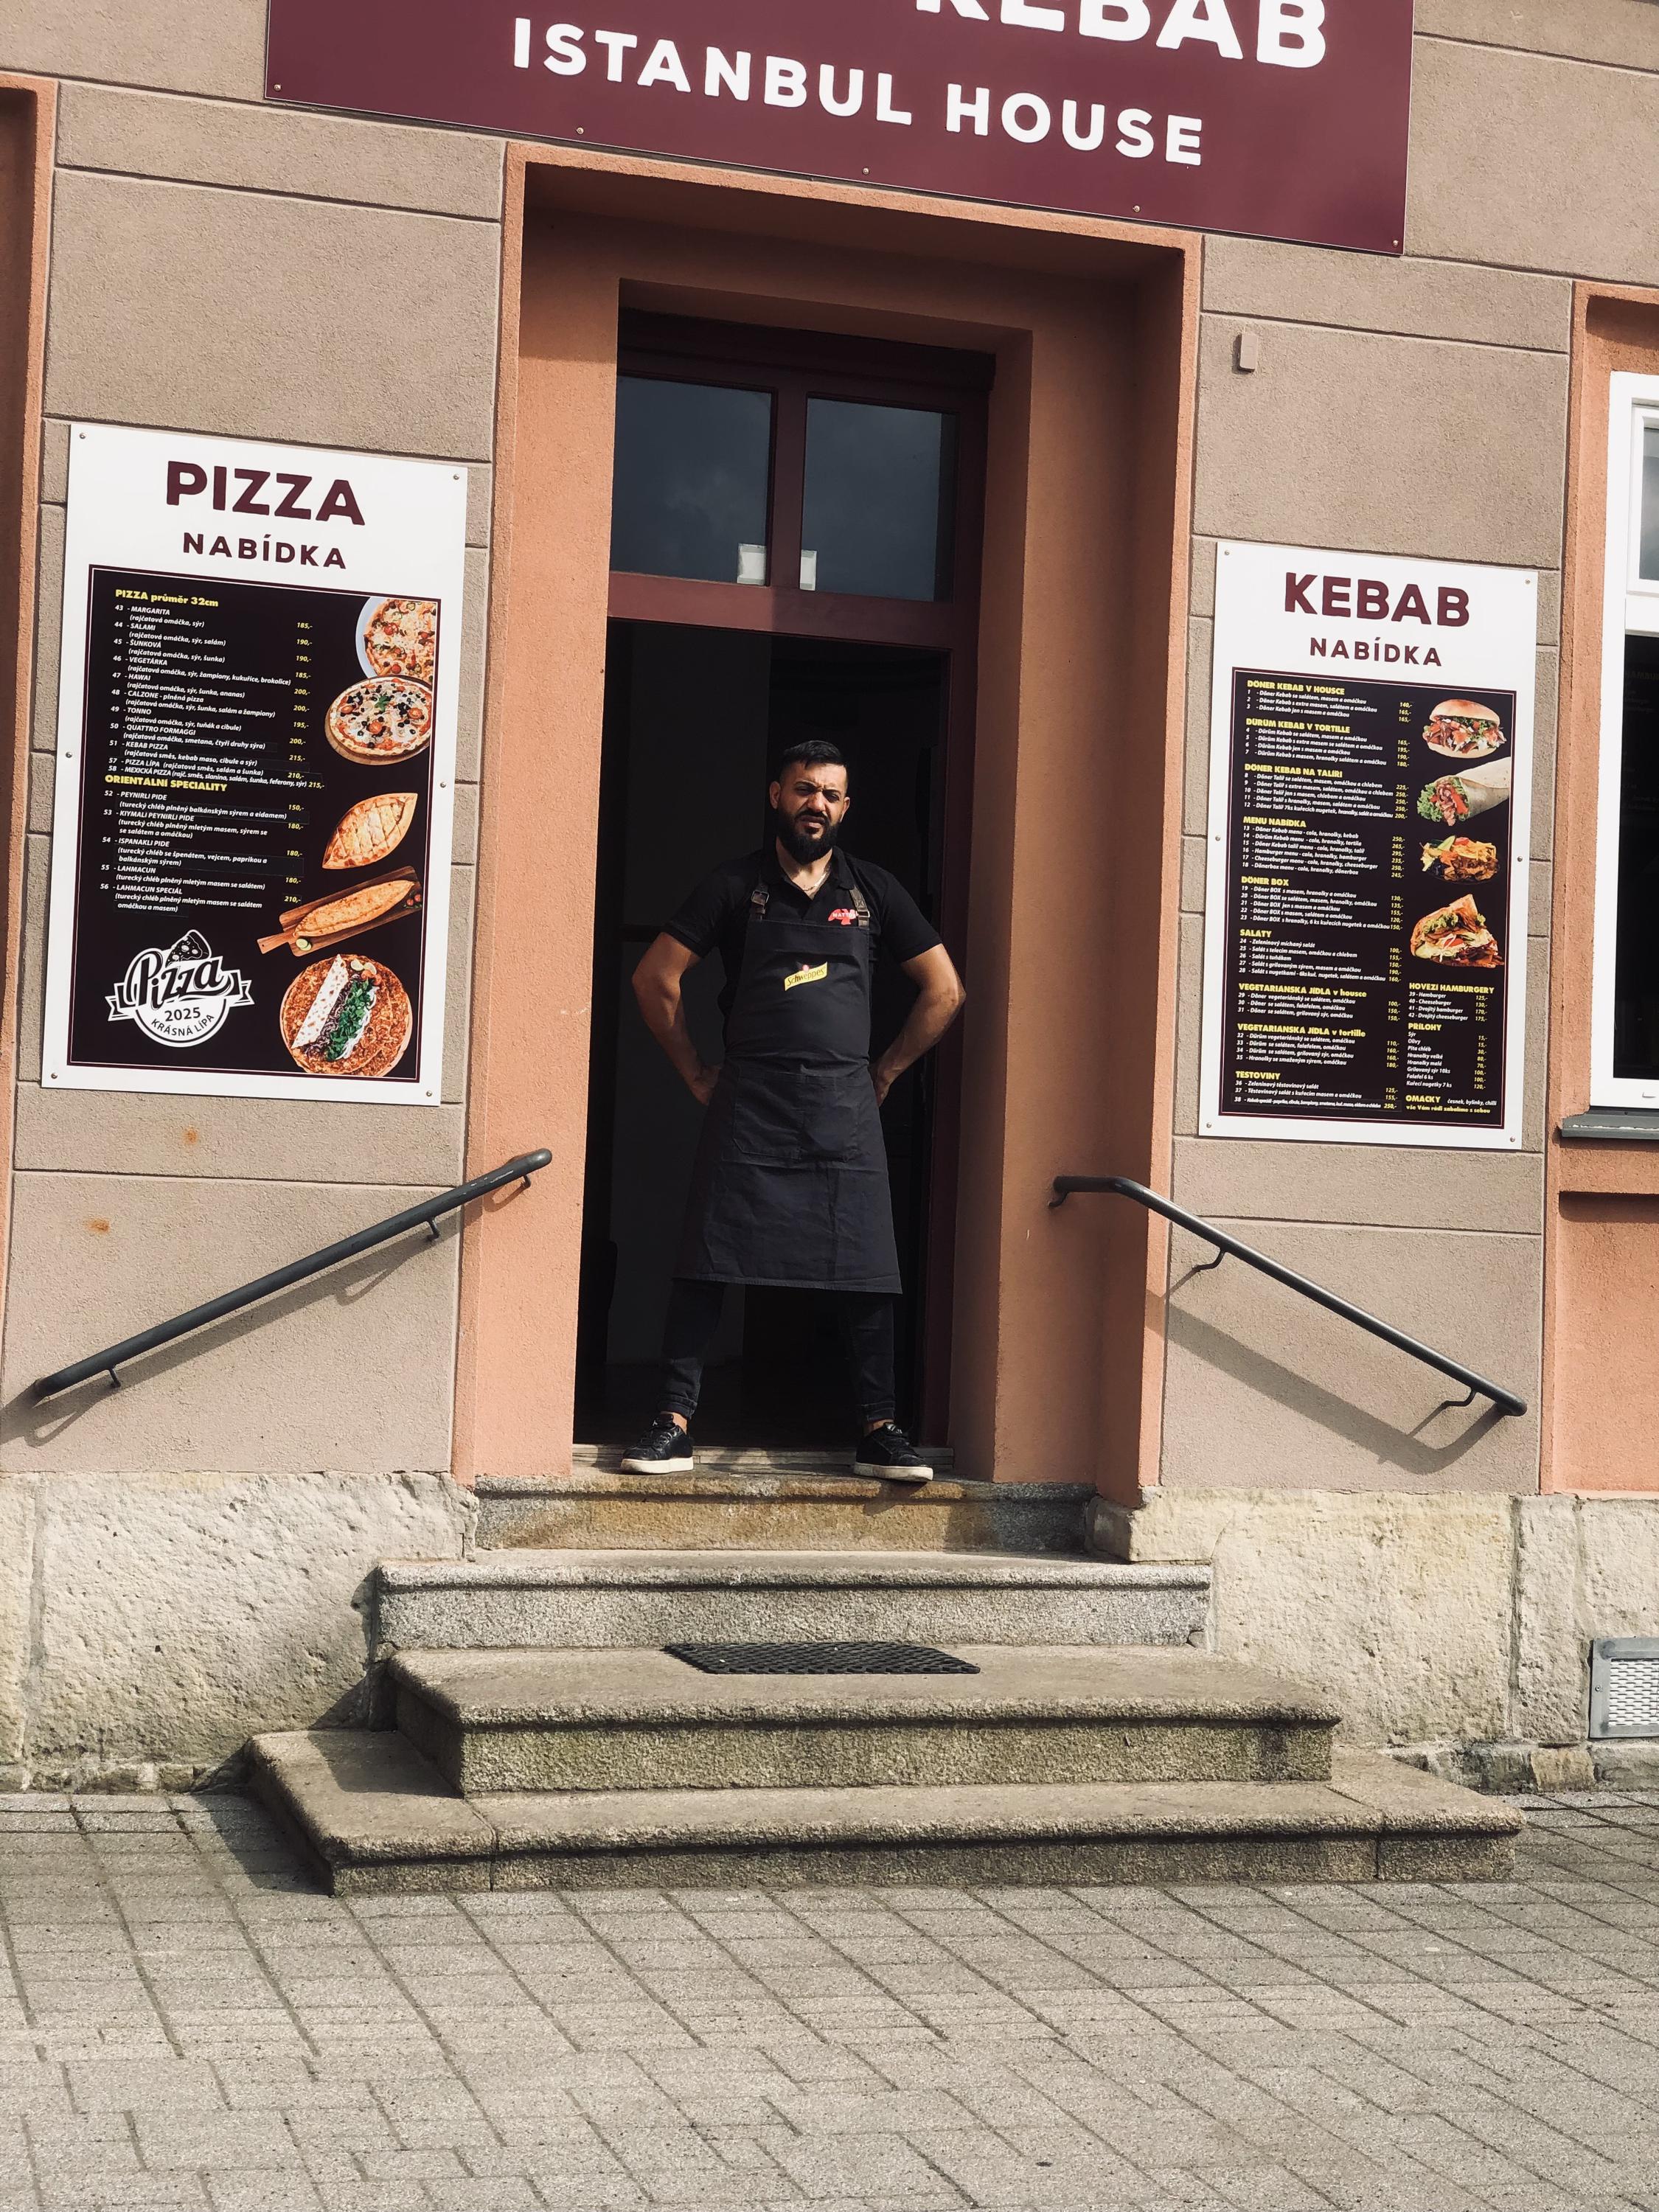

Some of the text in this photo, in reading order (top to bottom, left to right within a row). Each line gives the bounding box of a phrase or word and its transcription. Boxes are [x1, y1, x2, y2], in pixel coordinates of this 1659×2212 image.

[514, 18, 1202, 166] ISTANBUL HOUSE
[167, 460, 365, 526] PIZZA
[183, 532, 346, 569] NABÍDKA
[115, 588, 148, 599] PIZZA
[190, 597, 218, 607] 32cm
[1284, 572, 1470, 627] KEBAB
[131, 605, 170, 615] MARGARITA
[129, 614, 163, 623] (rajčatová
[163, 618, 191, 626] omáčka,
[130, 622, 156, 630] SALAMI
[128, 630, 162, 640] (rajčatová
[163, 635, 190, 643] omáčka,
[204, 639, 226, 647] salám)
[129, 639, 161, 648] ŠUNKOVÁ
[128, 647, 161, 656] (rajčatová
[162, 652, 189, 660] omáčka,
[203, 655, 225, 663] šunka)
[1310, 637, 1441, 667] NABÍDKA
[129, 656, 167, 666] VEGETÁRKA
[128, 664, 160, 673] (rajčatová
[159, 668, 187, 676] omáčka,
[199, 671, 231, 681] žampiony,
[232, 674, 260, 683] kukuřice,
[260, 676, 291, 686] brokolice)
[128, 673, 151, 681] HAWAI
[127, 681, 159, 690] (rajčatová
[159, 685, 186, 693] omáčka,
[187, 686, 198, 695] sýr,
[198, 688, 219, 696] šunka,
[1276, 682, 1304, 692] KEBAB
[1313, 686, 1345, 695] HOUSCE
[128, 690, 159, 698] CALZONE
[127, 706, 152, 715] TONNO
[126, 724, 159, 732] QUATTRO
[159, 726, 196, 735] FORMAGGI
[1278, 720, 1305, 729] KEBAB
[1314, 723, 1350, 734] TORTILLE
[125, 740, 148, 748] KEBAB
[125, 758, 145, 766] PIZZA
[163, 762, 196, 771] (rajčatová
[196, 765, 215, 773] směs,
[241, 768, 263, 776] šunka)
[170, 779, 227, 791] SPECIALITY
[1242, 815, 1267, 825] MENU
[288, 822, 304, 830] 180,-
[160, 830, 193, 839] omáčkou)
[118, 855, 181, 866] balkánským sýrem)
[116, 865, 156, 874] LAHMACUN
[1270, 877, 1289, 886] BOX
[116, 884, 156, 892] LAHMACUN
[155, 886, 182, 894] SPECIÁL
[117, 902, 147, 910] omáčkou
[126, 950, 232, 1009] Pizza
[787, 968, 824, 987] Schweppes
[1340, 988, 1367, 997] housce
[1439, 984, 1495, 994] HAMBURGERY
[1418, 991, 1447, 999] Hamburger
[1418, 998, 1452, 1006] Cheeseburger
[164, 1007, 201, 1022] 2025
[1436, 1006, 1463, 1014] hamburger
[1436, 1013, 1468, 1021] cheeseburger
[151, 1014, 215, 1037] KRÁSNÁ LÍPA
